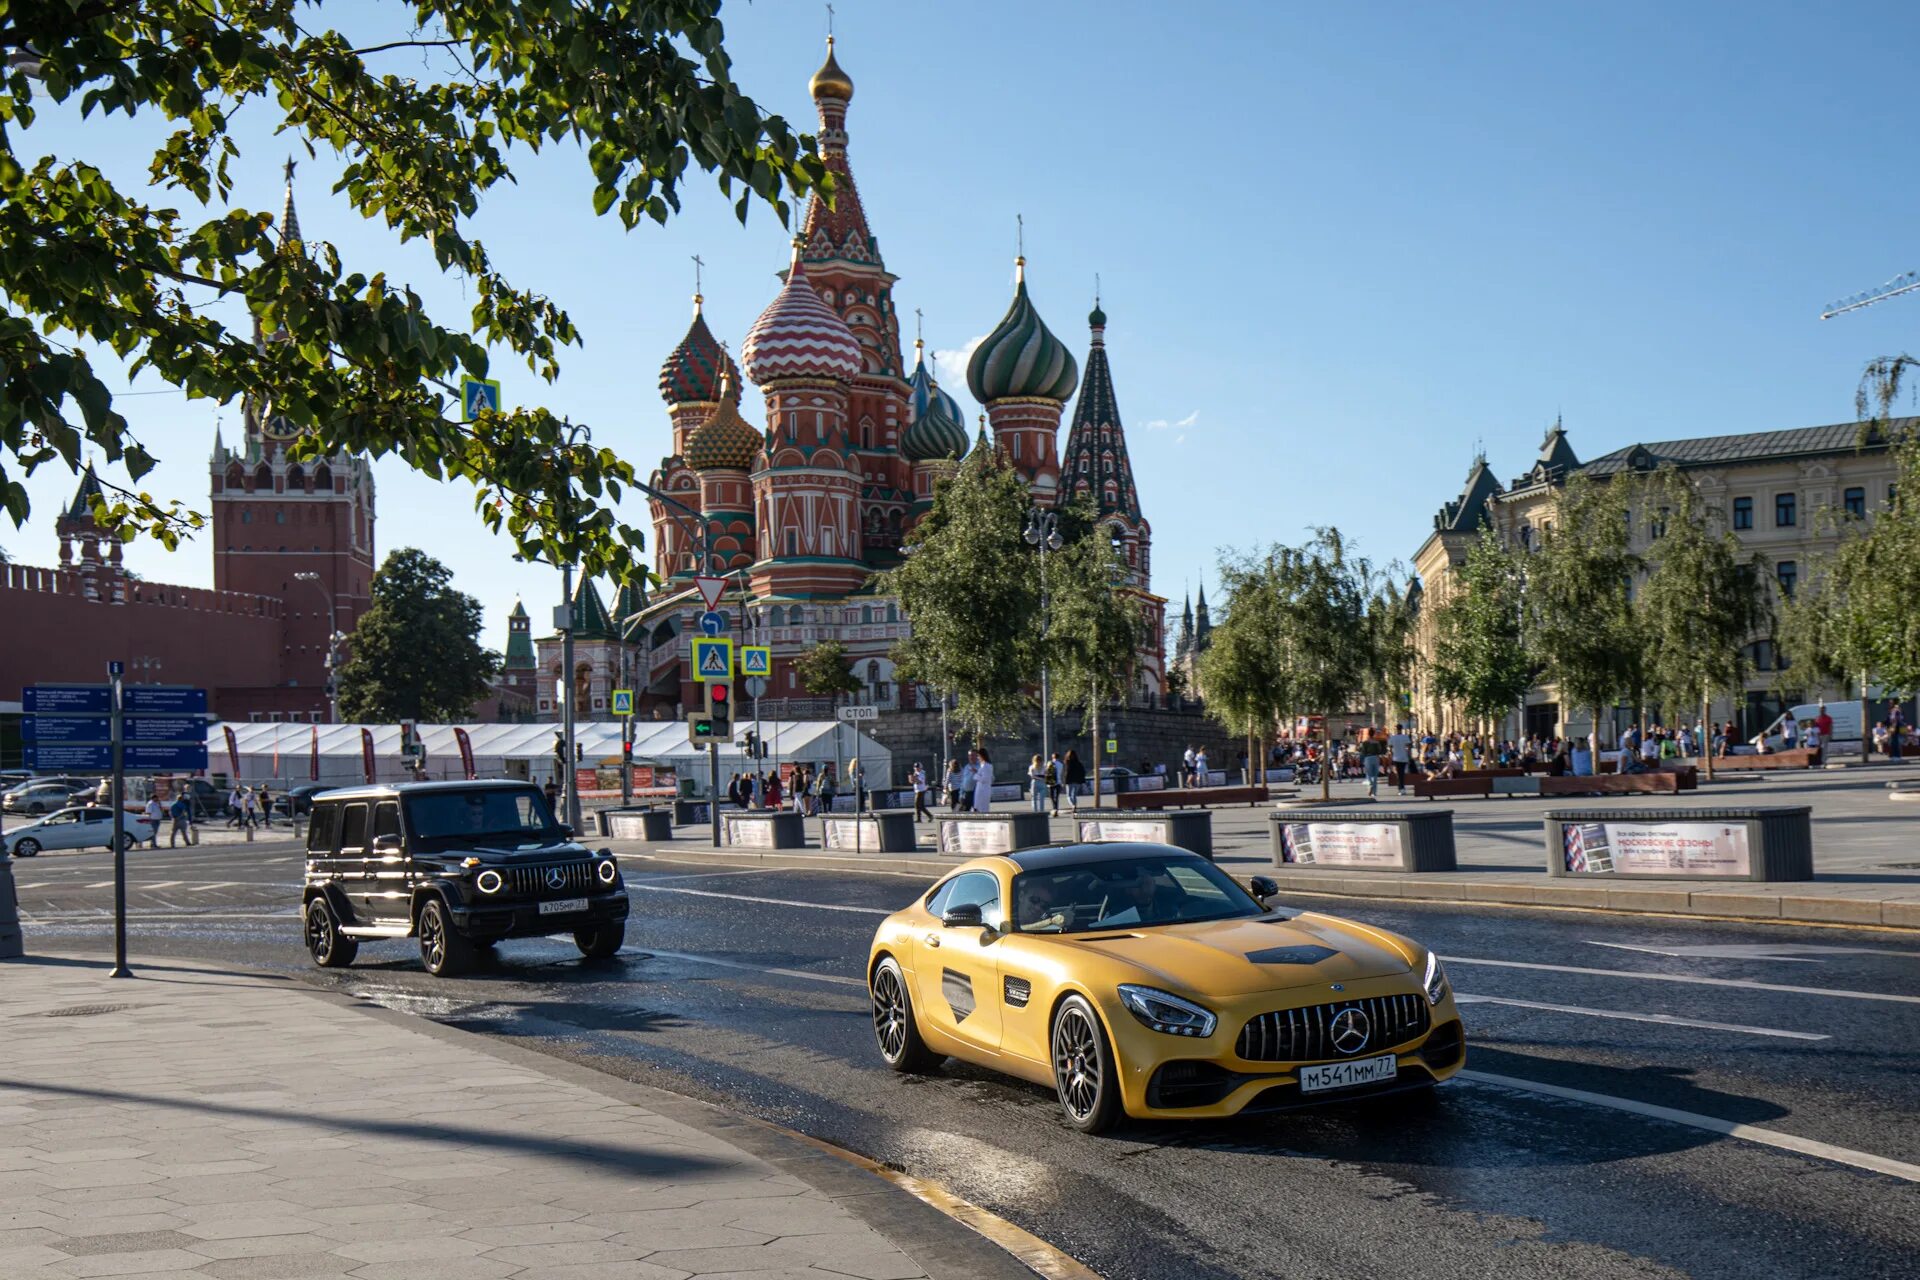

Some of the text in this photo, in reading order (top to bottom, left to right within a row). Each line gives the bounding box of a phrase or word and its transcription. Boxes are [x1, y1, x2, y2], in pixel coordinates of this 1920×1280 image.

[845, 708, 872, 718] СТОП
[1676, 839, 1713, 848] СЕЗОНЫ
[1377, 1057, 1391, 1072] 77
